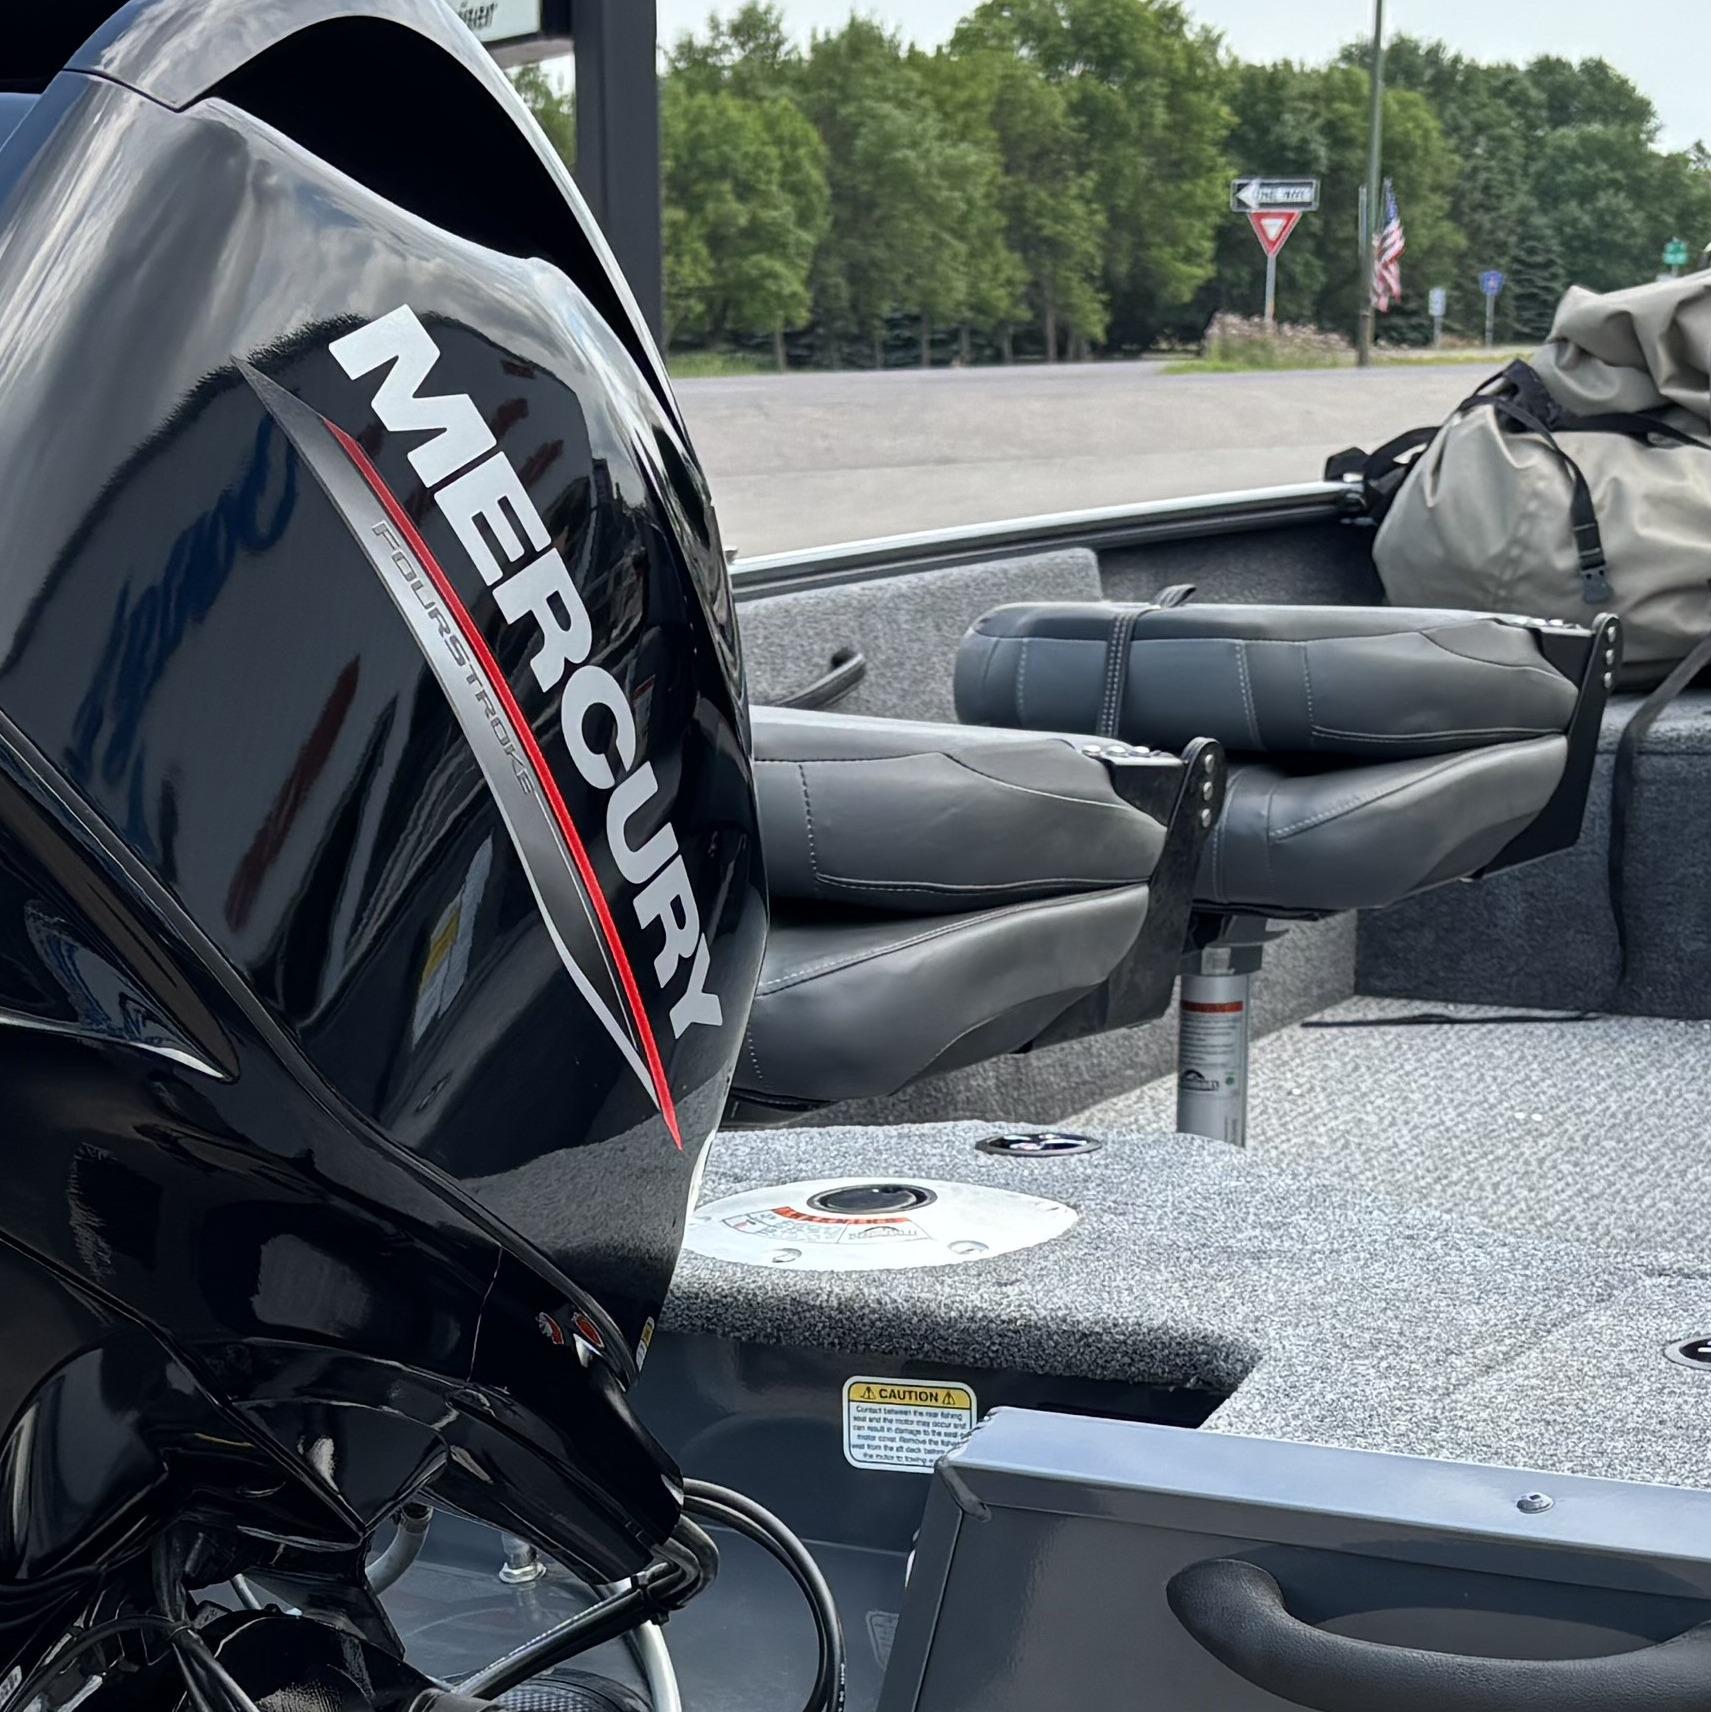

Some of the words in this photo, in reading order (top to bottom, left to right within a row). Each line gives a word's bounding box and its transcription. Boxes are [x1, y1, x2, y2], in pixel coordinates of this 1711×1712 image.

[329, 303, 722, 1039] MERCURY
[372, 520, 538, 795] FOURSTROKE
[879, 1388, 939, 1402] CAUTION
